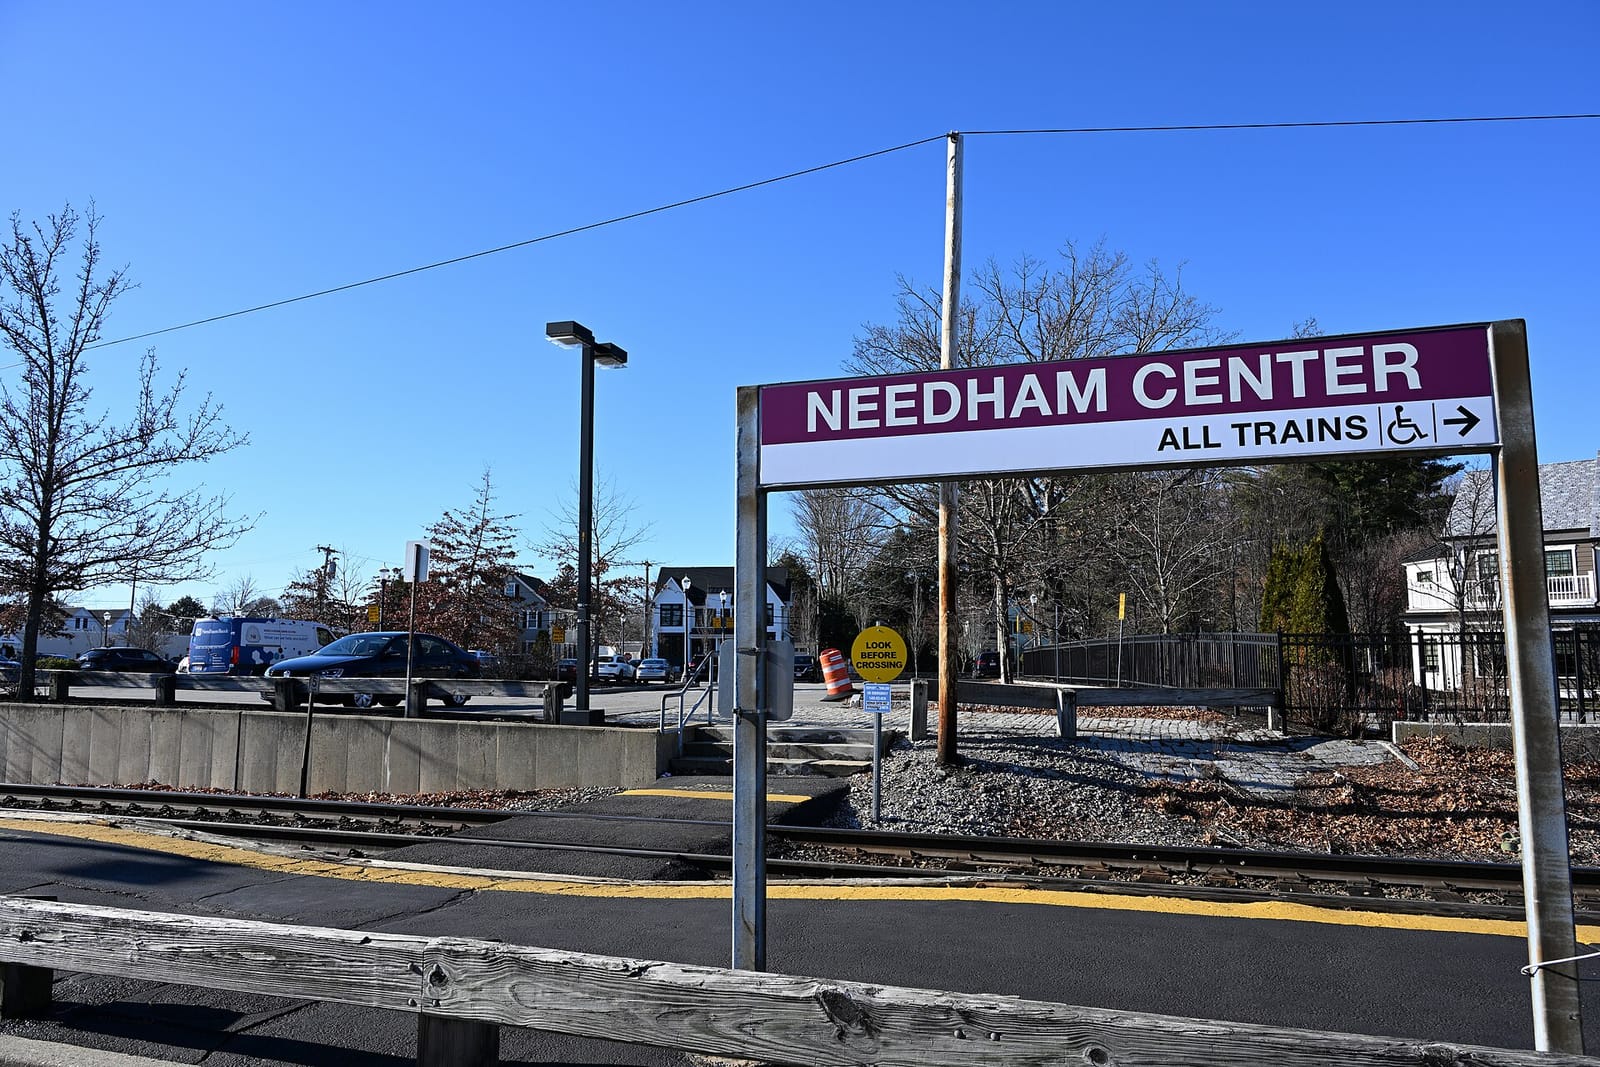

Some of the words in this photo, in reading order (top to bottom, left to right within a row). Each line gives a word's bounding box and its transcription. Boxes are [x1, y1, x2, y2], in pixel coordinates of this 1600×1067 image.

[807, 368, 1107, 433] NEEDHAM
[1133, 343, 1422, 409] CENTER
[1157, 425, 1222, 452] ALL
[1230, 414, 1368, 447] TRAINS
[866, 641, 892, 649] LOOK
[861, 651, 897, 659] BEFORE
[856, 661, 903, 669] CROSSING
